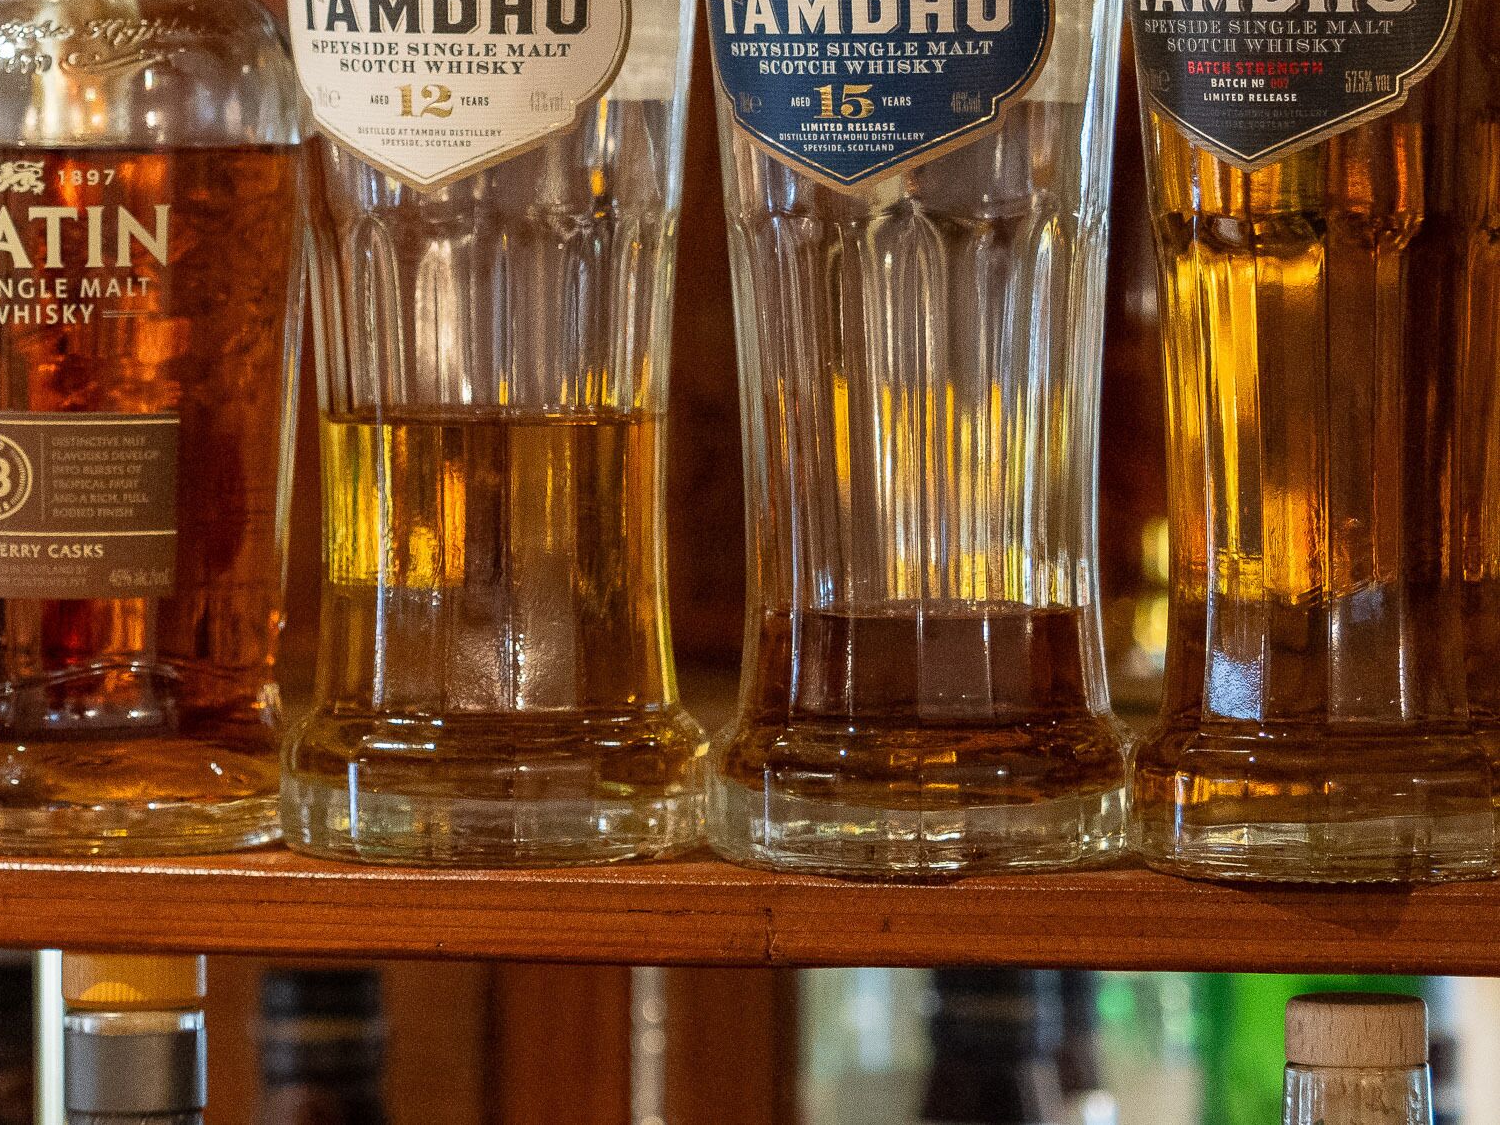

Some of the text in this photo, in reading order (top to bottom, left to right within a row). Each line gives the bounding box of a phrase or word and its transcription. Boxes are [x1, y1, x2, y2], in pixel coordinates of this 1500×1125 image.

[1144, 19, 1394, 35] SPEYSIDE SINGLE MALT
[311, 40, 572, 58] SPEYSIDE SINGLE MALT
[730, 41, 994, 57] SPEYSIDE SINGLE MALT
[1167, 38, 1347, 53] SCOTCH WHISKY
[339, 59, 526, 76] SCOTCH WHISKY
[758, 59, 948, 76] SCOTCH WHISKY
[1187, 61, 1323, 75] BATCH STRENGTH
[1211, 78, 1247, 88] BATCH
[1375, 75, 1391, 92] VOL
[369, 83, 490, 118] AGED 12 YEARS
[790, 83, 912, 119] AGED 15 YEARS
[1203, 92, 1298, 102] LIMITED RELEASE
[357, 126, 502, 137] DISTILLED AT TAMDHU DISTILLERY
[800, 122, 896, 132] LIMITED RELEASE
[425, 139, 472, 148] SCOTLAND
[779, 132, 925, 142] DISTILLED AT TAMDHU DISTILLERY
[803, 143, 895, 153] SPEYSIDE, SCOTLAND
[57, 169, 116, 186] 1897
[80, 276, 152, 299] MALT
[47, 543, 105, 559] CASKS
